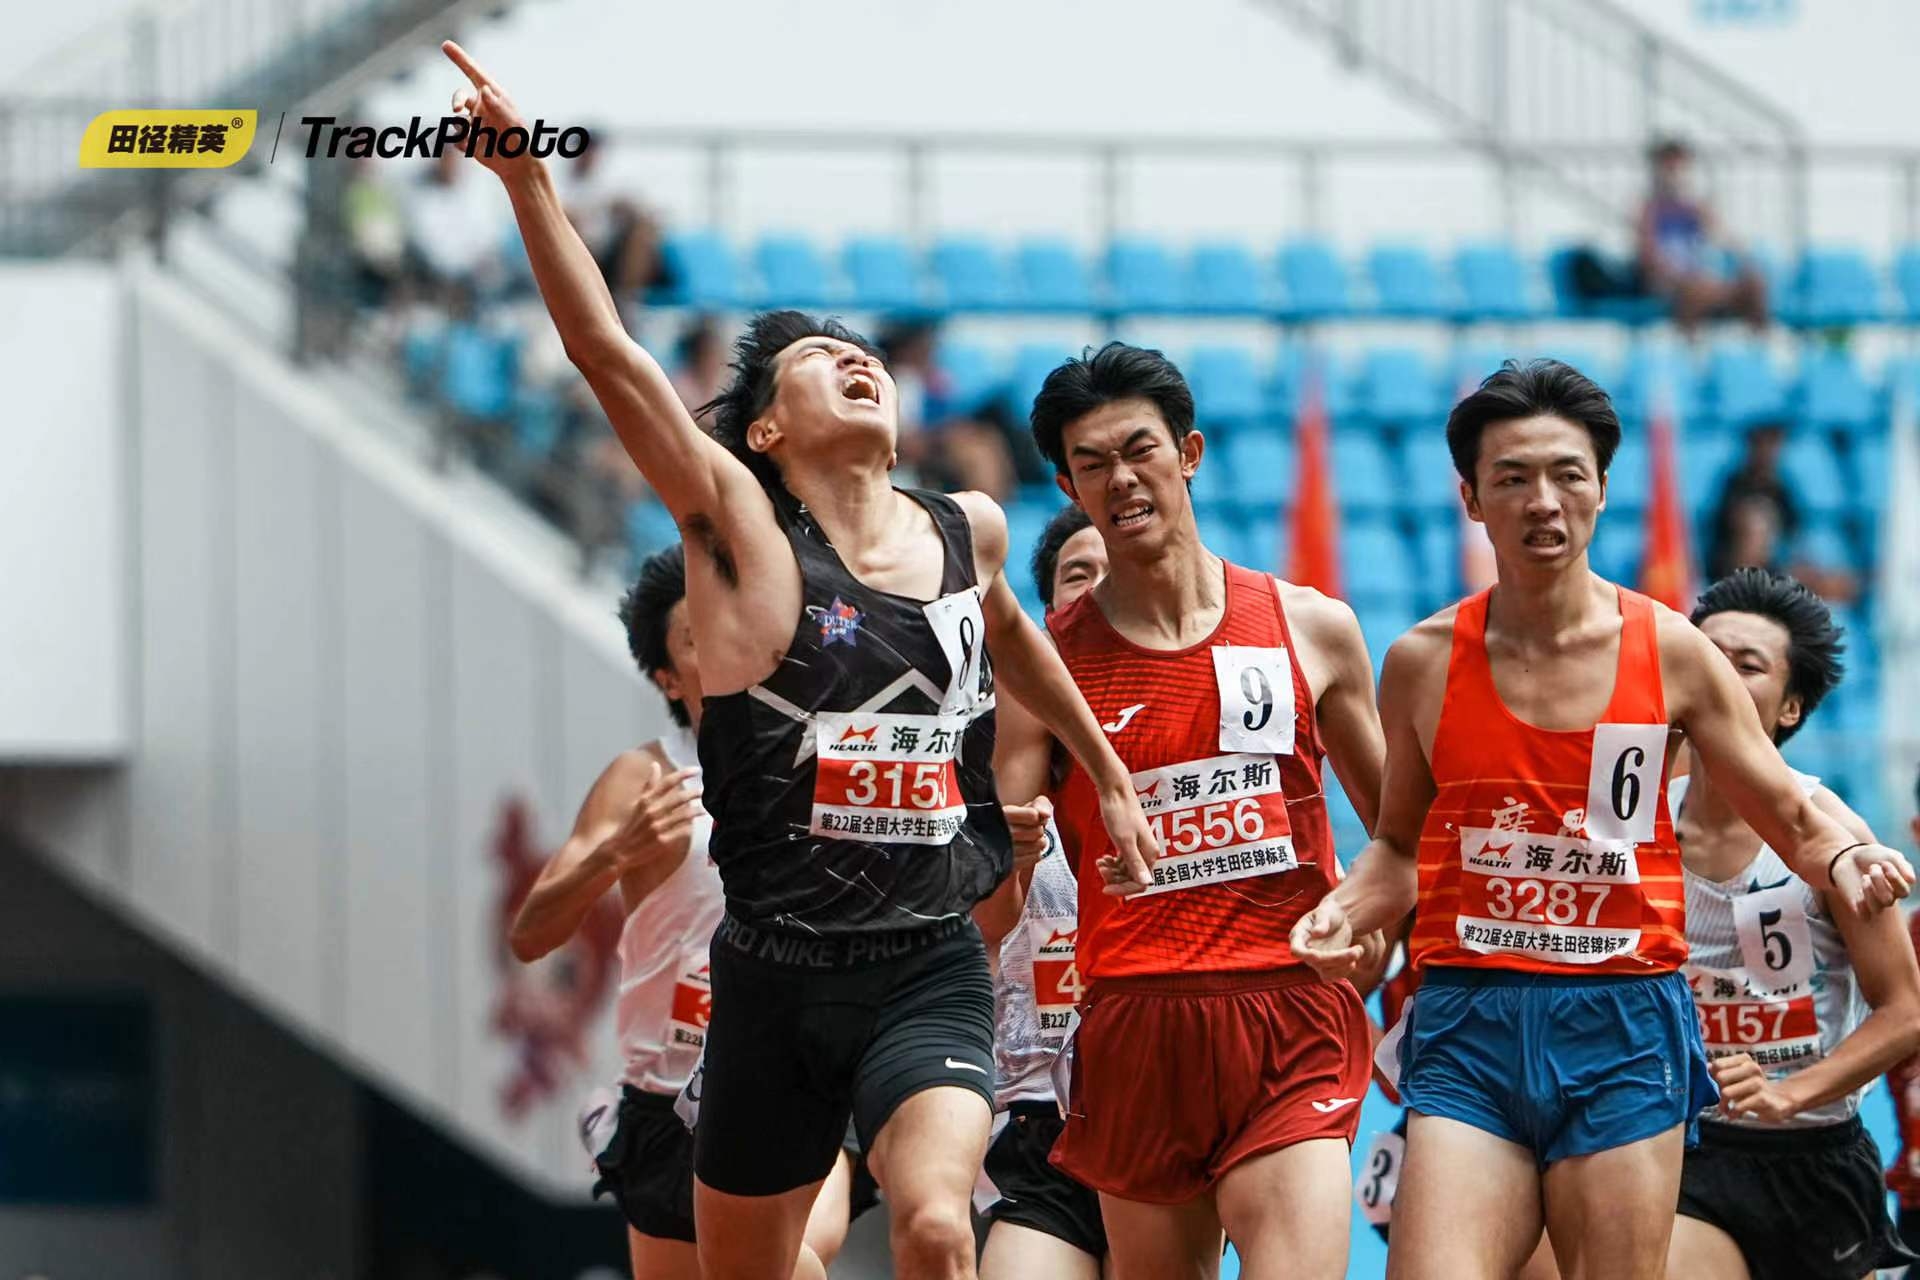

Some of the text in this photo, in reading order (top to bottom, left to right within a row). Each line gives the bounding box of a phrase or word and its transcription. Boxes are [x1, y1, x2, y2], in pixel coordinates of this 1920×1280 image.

[959, 616, 975, 691] 8
[1240, 666, 1274, 731] 9
[829, 743, 878, 752] HEALTH
[1172, 761, 1273, 802] 海尔斯
[1611, 746, 1645, 821] 6
[1149, 797, 1265, 857] 4556
[1148, 845, 1289, 887] 届全国大学生田径锦标赛
[1469, 856, 1512, 869] HEALTH
[1524, 844, 1627, 876] 海尔斯
[1486, 877, 1612, 926] 3287
[757, 933, 834, 967] NIKE
[1759, 908, 1792, 971] 5
[1363, 1148, 1393, 1208] 3
